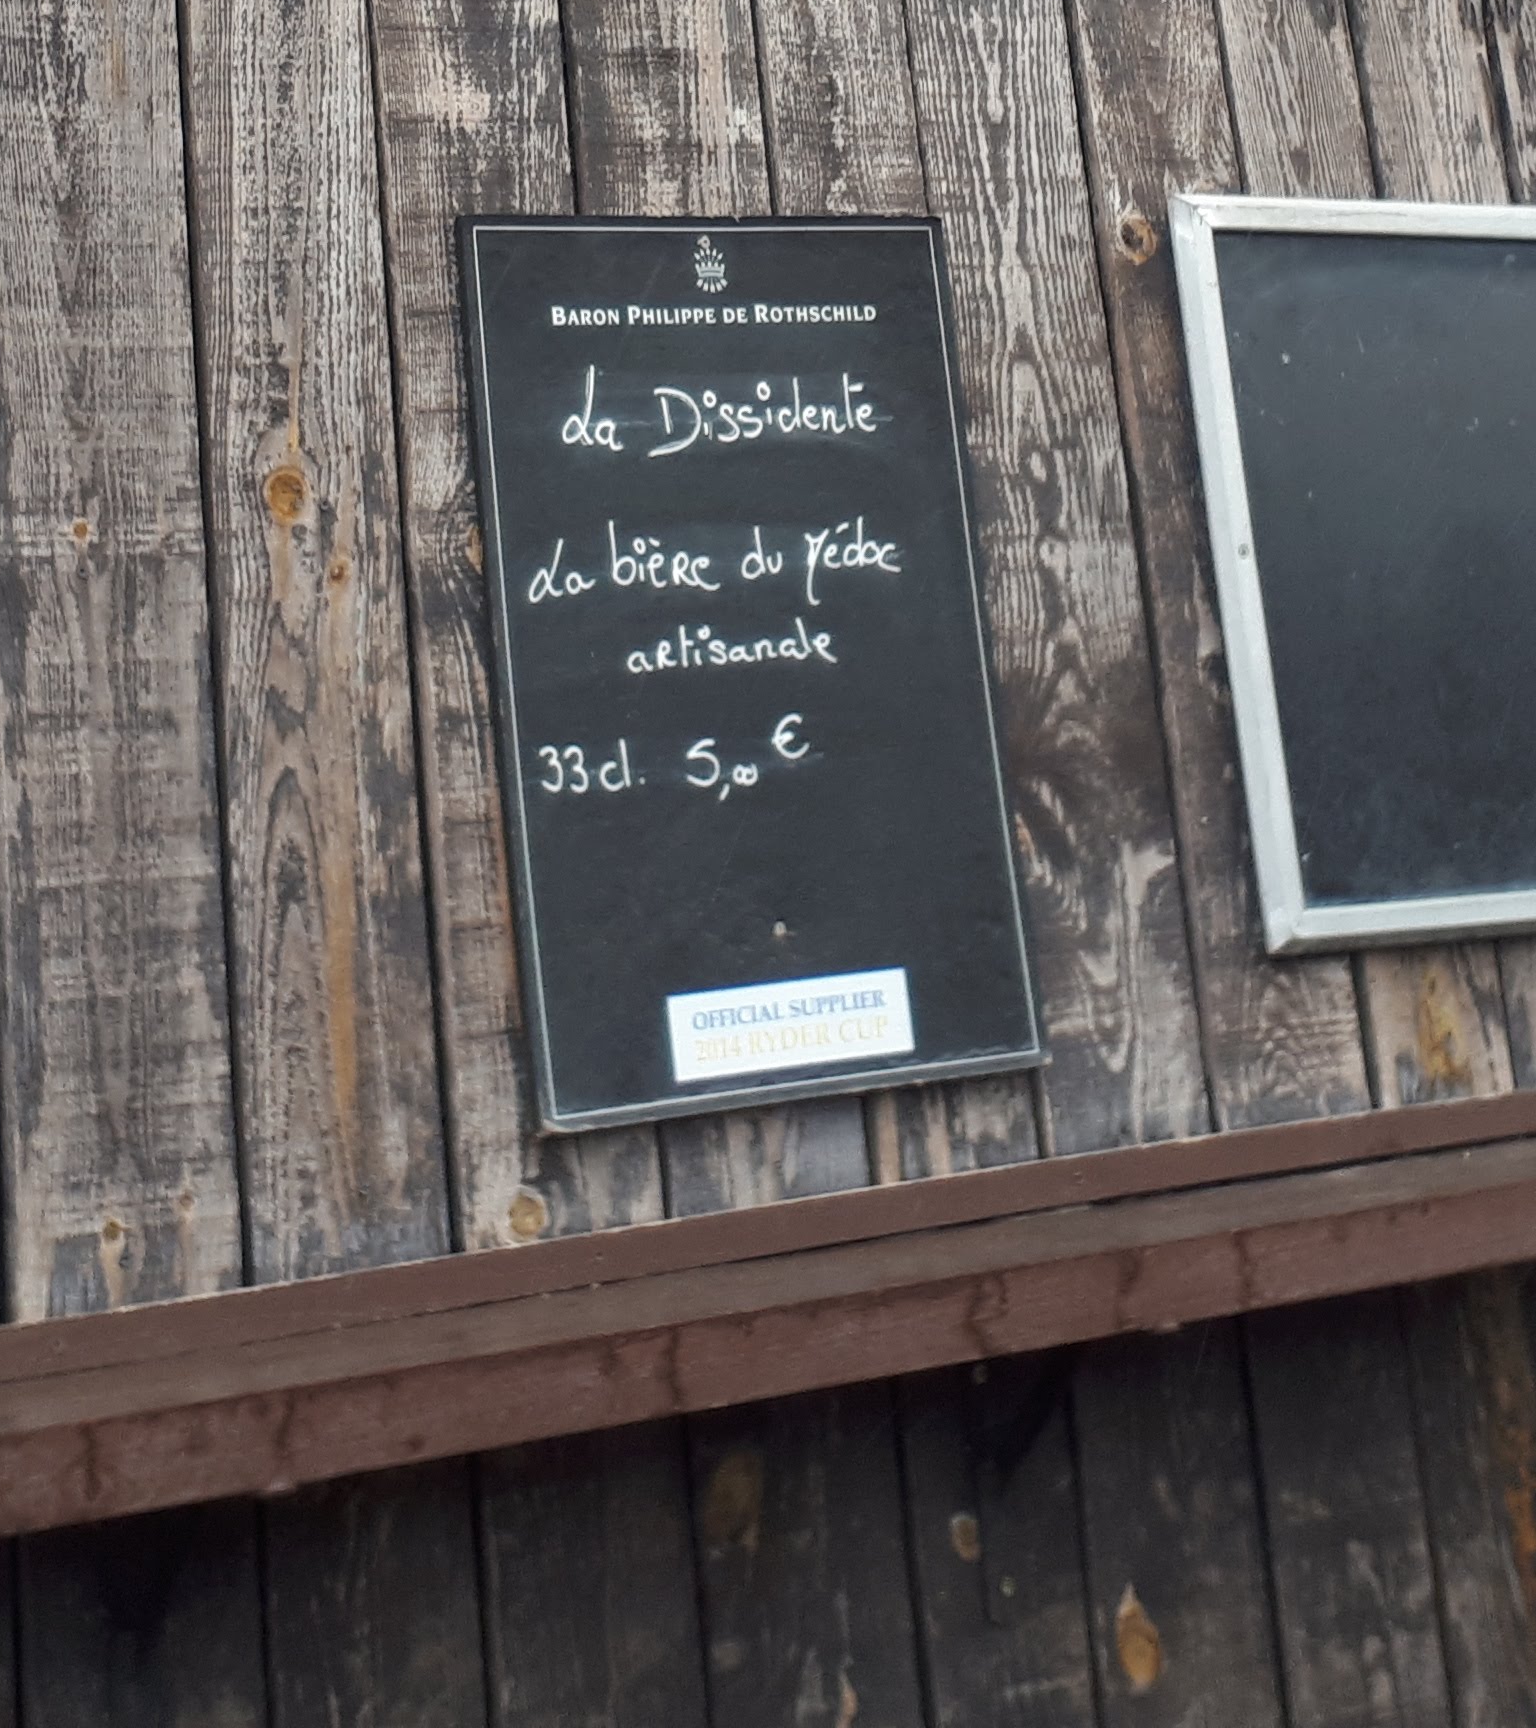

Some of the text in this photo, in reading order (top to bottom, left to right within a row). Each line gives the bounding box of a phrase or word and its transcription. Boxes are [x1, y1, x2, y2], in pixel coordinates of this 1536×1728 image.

[562, 365, 623, 451] La
[528, 538, 595, 604] La
[741, 525, 783, 580] du
[627, 618, 838, 673] artisanale
[692, 989, 887, 1030] OFFICIAL SUPPLIER
[749, 1022, 831, 1055] RYDER
[838, 1015, 888, 1043] CUP
